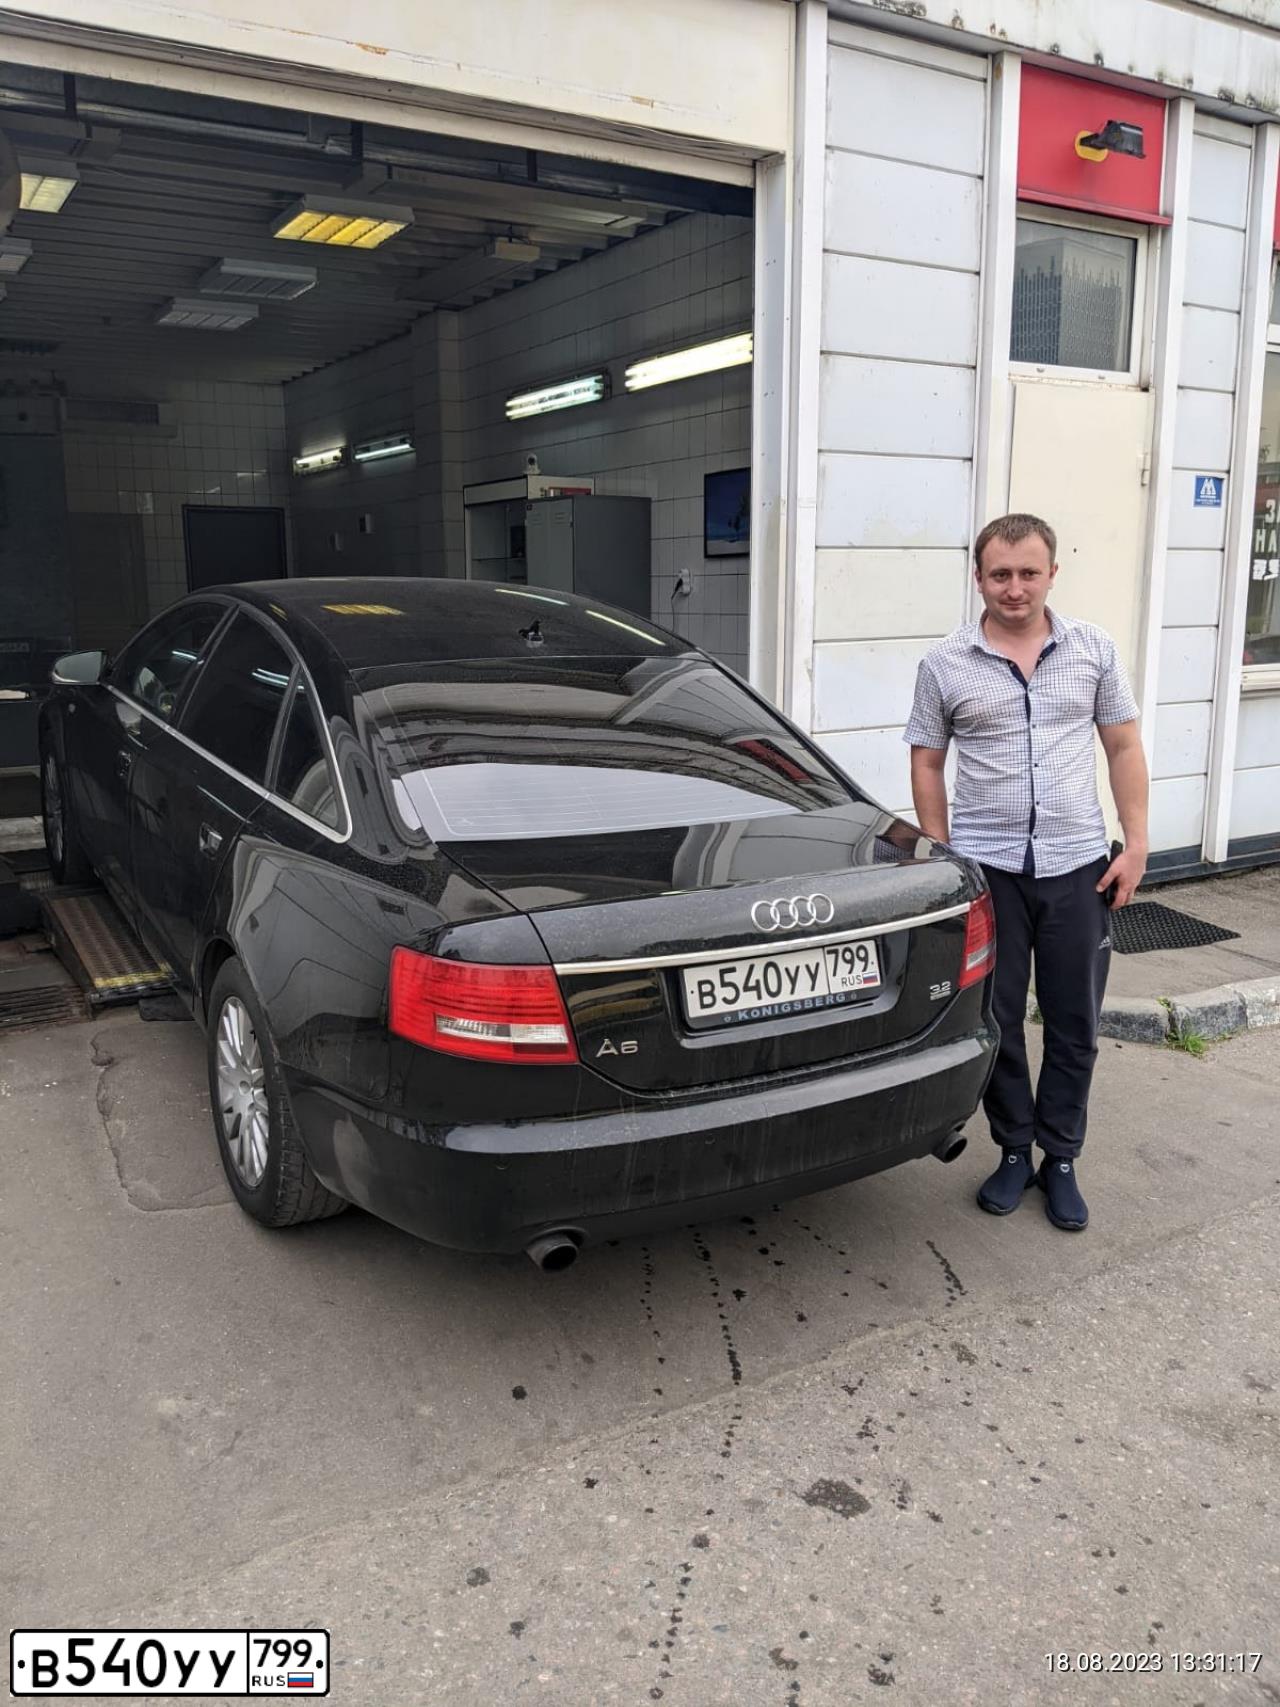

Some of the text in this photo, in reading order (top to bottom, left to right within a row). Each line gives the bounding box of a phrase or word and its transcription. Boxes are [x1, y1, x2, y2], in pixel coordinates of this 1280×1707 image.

[697, 944, 869, 1010] В540УУ 799
[841, 974, 863, 987] RUS
[595, 1038, 639, 1057] A6
